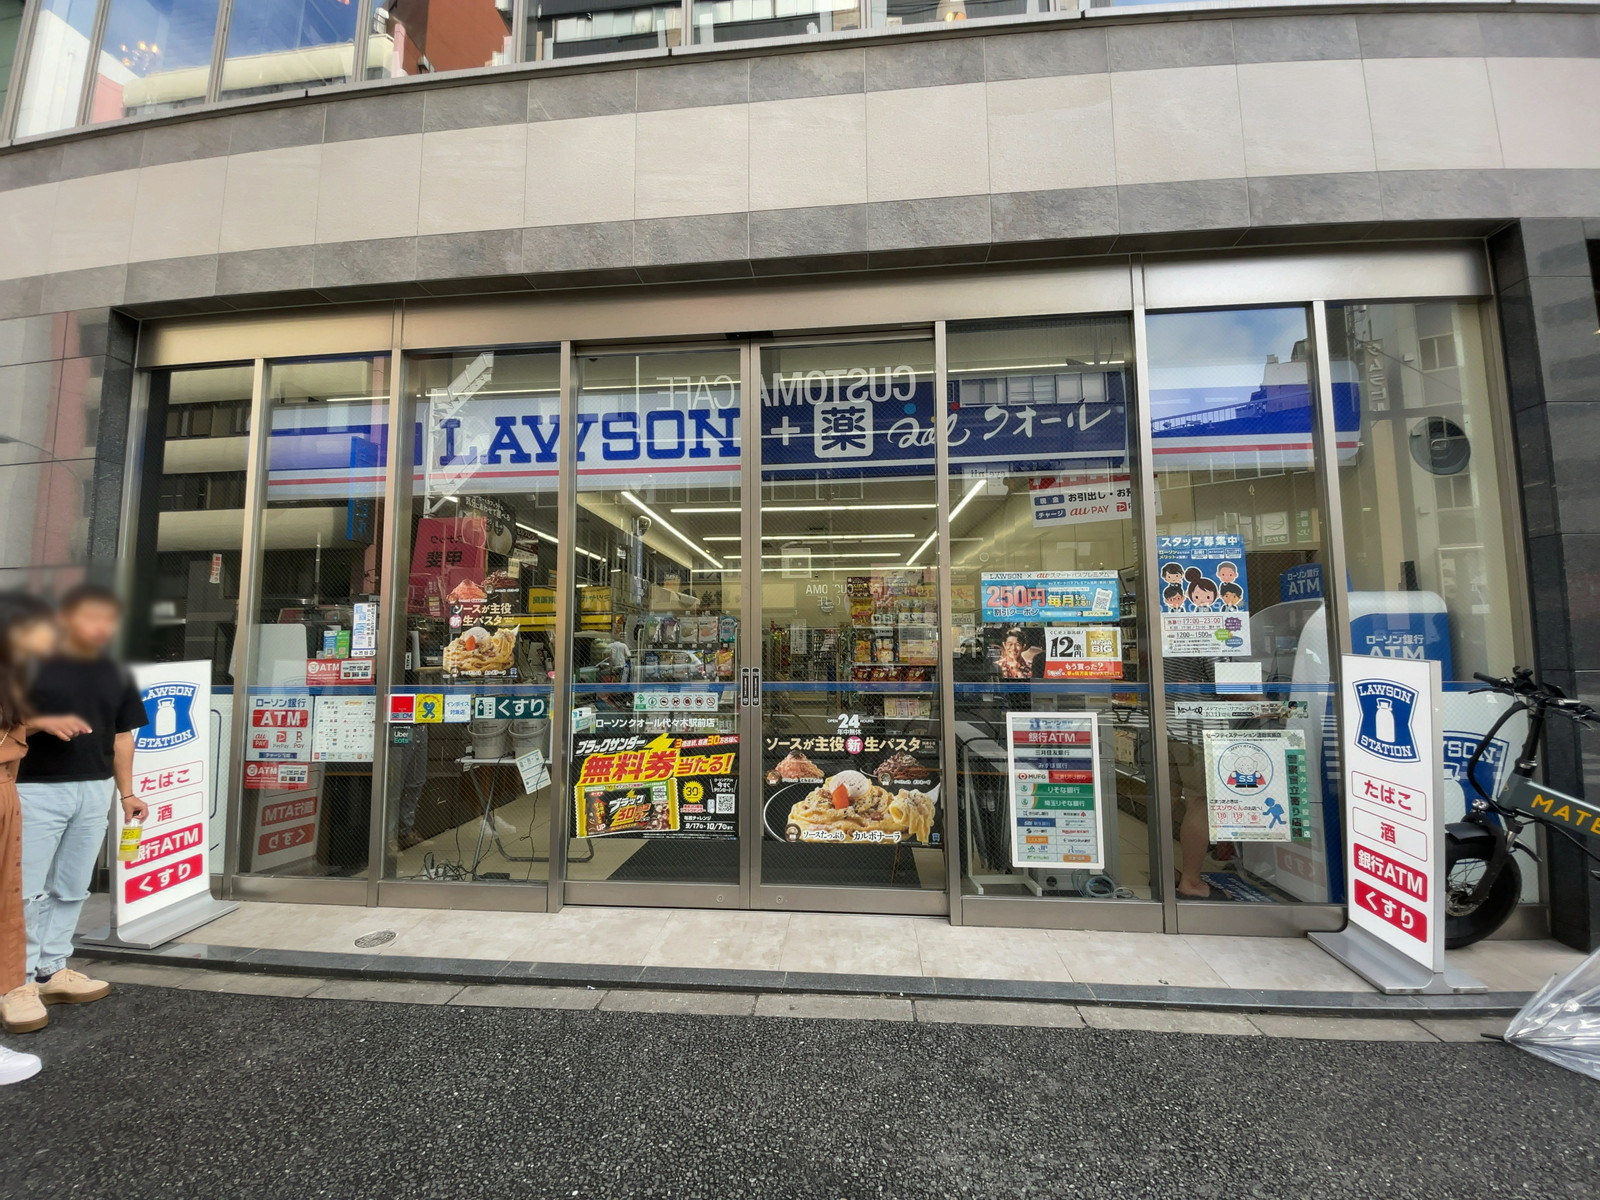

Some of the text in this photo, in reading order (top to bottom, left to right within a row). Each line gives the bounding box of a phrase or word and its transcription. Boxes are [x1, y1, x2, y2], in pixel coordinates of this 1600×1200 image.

[821, 406, 867, 452] 薬
[982, 399, 1112, 442] クオール
[440, 408, 741, 466] LAWSON
[1070, 506, 1091, 517] au
[1091, 505, 1110, 515] PAY
[1161, 535, 1238, 547] スタッフ募集中
[1287, 568, 1320, 582] ローソン銀行
[1289, 578, 1320, 595] ATM
[986, 584, 1076, 608] 250円 毎月
[454, 602, 513, 615] ソースが主役
[993, 608, 1040, 617] 割引クーポン
[463, 614, 503, 627] 生パスタ
[1050, 636, 1074, 659] 12
[1366, 634, 1424, 645] ローソン銀行
[1091, 645, 1113, 654] BIG
[1368, 645, 1424, 660] ATM
[319, 663, 340, 672] ATM
[141, 685, 194, 702] AWSON
[1358, 684, 1412, 705] LAWSON
[255, 697, 307, 708] ローソン銀行
[498, 699, 545, 716] くすり
[260, 711, 301, 727] ATM
[595, 718, 715, 728] ローソンクオール代々木駅前店
[837, 713, 861, 729] 24
[137, 729, 193, 748] STATION
[837, 728, 862, 736] 年中無休
[1028, 732, 1076, 743] 銀行ATM
[576, 735, 647, 755] ブラックサンダー
[766, 736, 845, 752] ソースが主役
[847, 738, 862, 754] 新
[864, 736, 921, 752] 生パスタ
[1360, 734, 1413, 758] STATION
[258, 766, 278, 775] ATM
[139, 768, 191, 793] たばこ
[1239, 775, 1254, 783] SS
[1047, 786, 1080, 794] りそな銀行
[1364, 779, 1412, 811] たばこ
[609, 794, 647, 814] ブラック
[156, 803, 173, 822] 酒
[596, 823, 607, 832] UP
[1380, 822, 1396, 844] 酒
[802, 830, 901, 843] ソースたっぷり カルボナーラ
[138, 861, 191, 893] くすり
[1358, 849, 1423, 897] 銀行ATM
[1365, 891, 1414, 931] くすり
